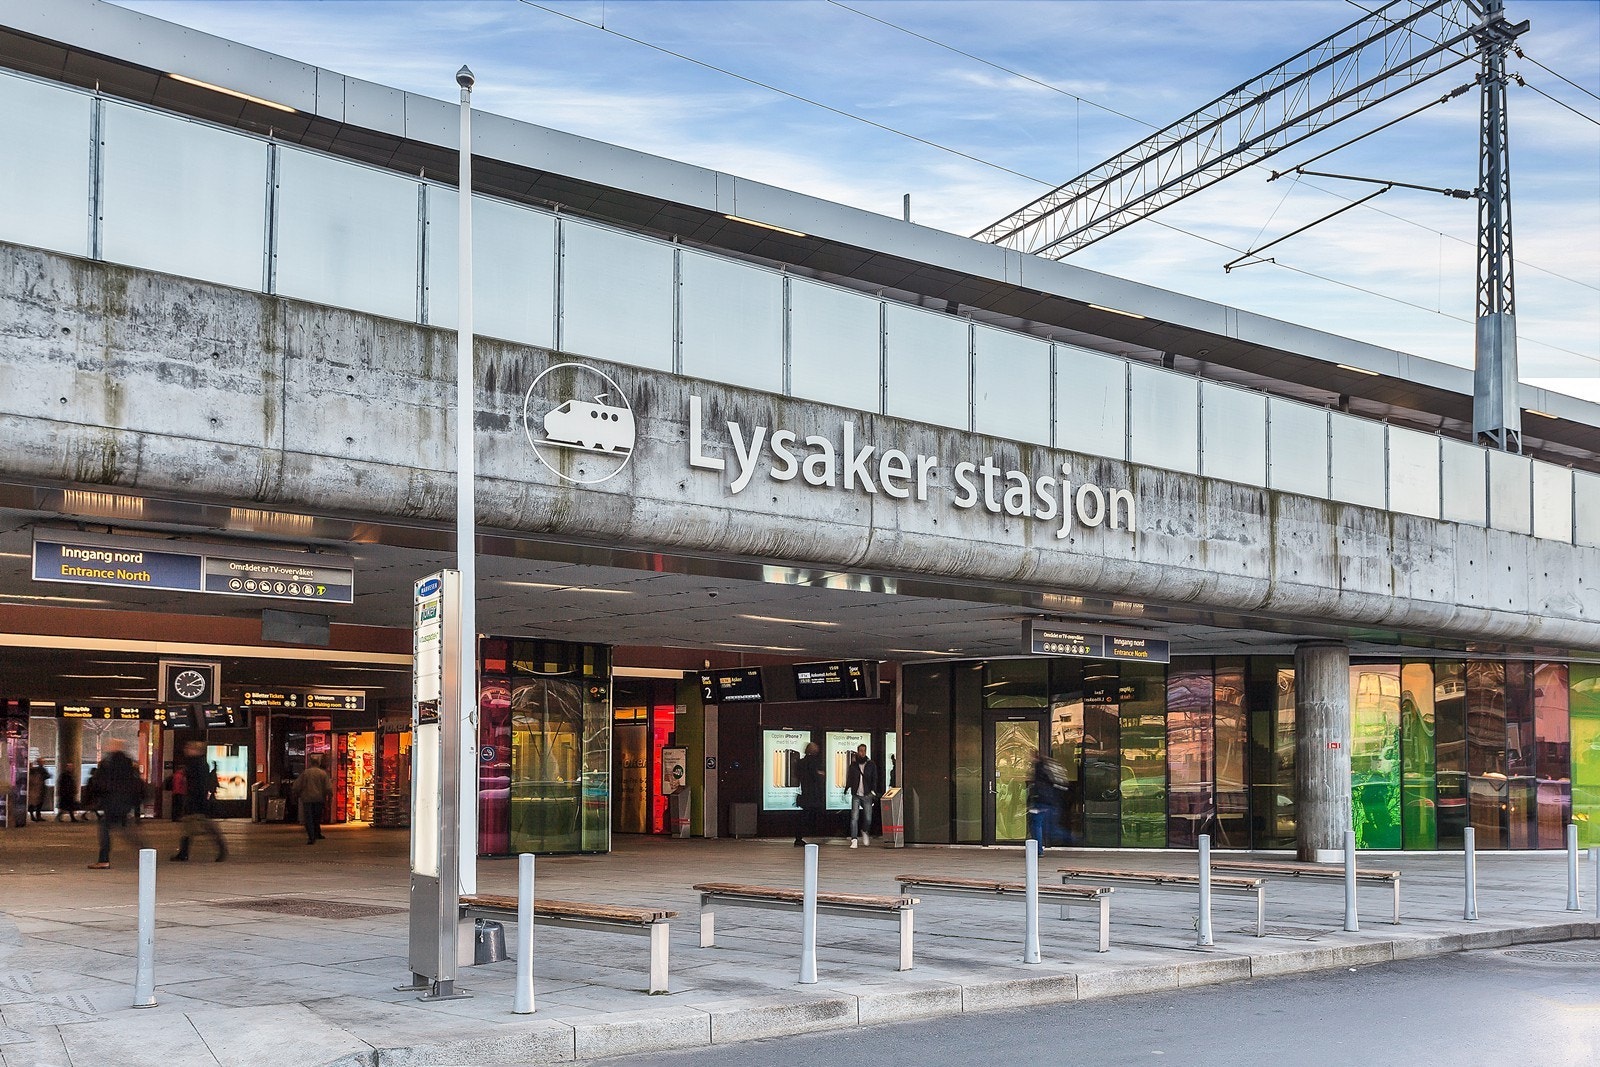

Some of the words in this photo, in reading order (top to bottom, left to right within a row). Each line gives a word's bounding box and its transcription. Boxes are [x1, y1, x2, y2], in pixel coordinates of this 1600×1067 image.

[689, 394, 938, 501] Lysaker
[953, 455, 1137, 540] stasjon
[61, 546, 113, 563] Inngang
[114, 552, 143, 564] nord
[61, 564, 115, 579] Entrance
[116, 569, 151, 582] North
[229, 562, 261, 573] Området
[261, 566, 269, 574] er
[269, 566, 314, 577] TV-overvåket
[1113, 637, 1133, 647] Inngang
[1133, 639, 1145, 648] nord
[1113, 648, 1134, 657] Entrance
[1134, 649, 1148, 658] North
[853, 678, 859, 691] 1
[704, 687, 712, 699] 2
